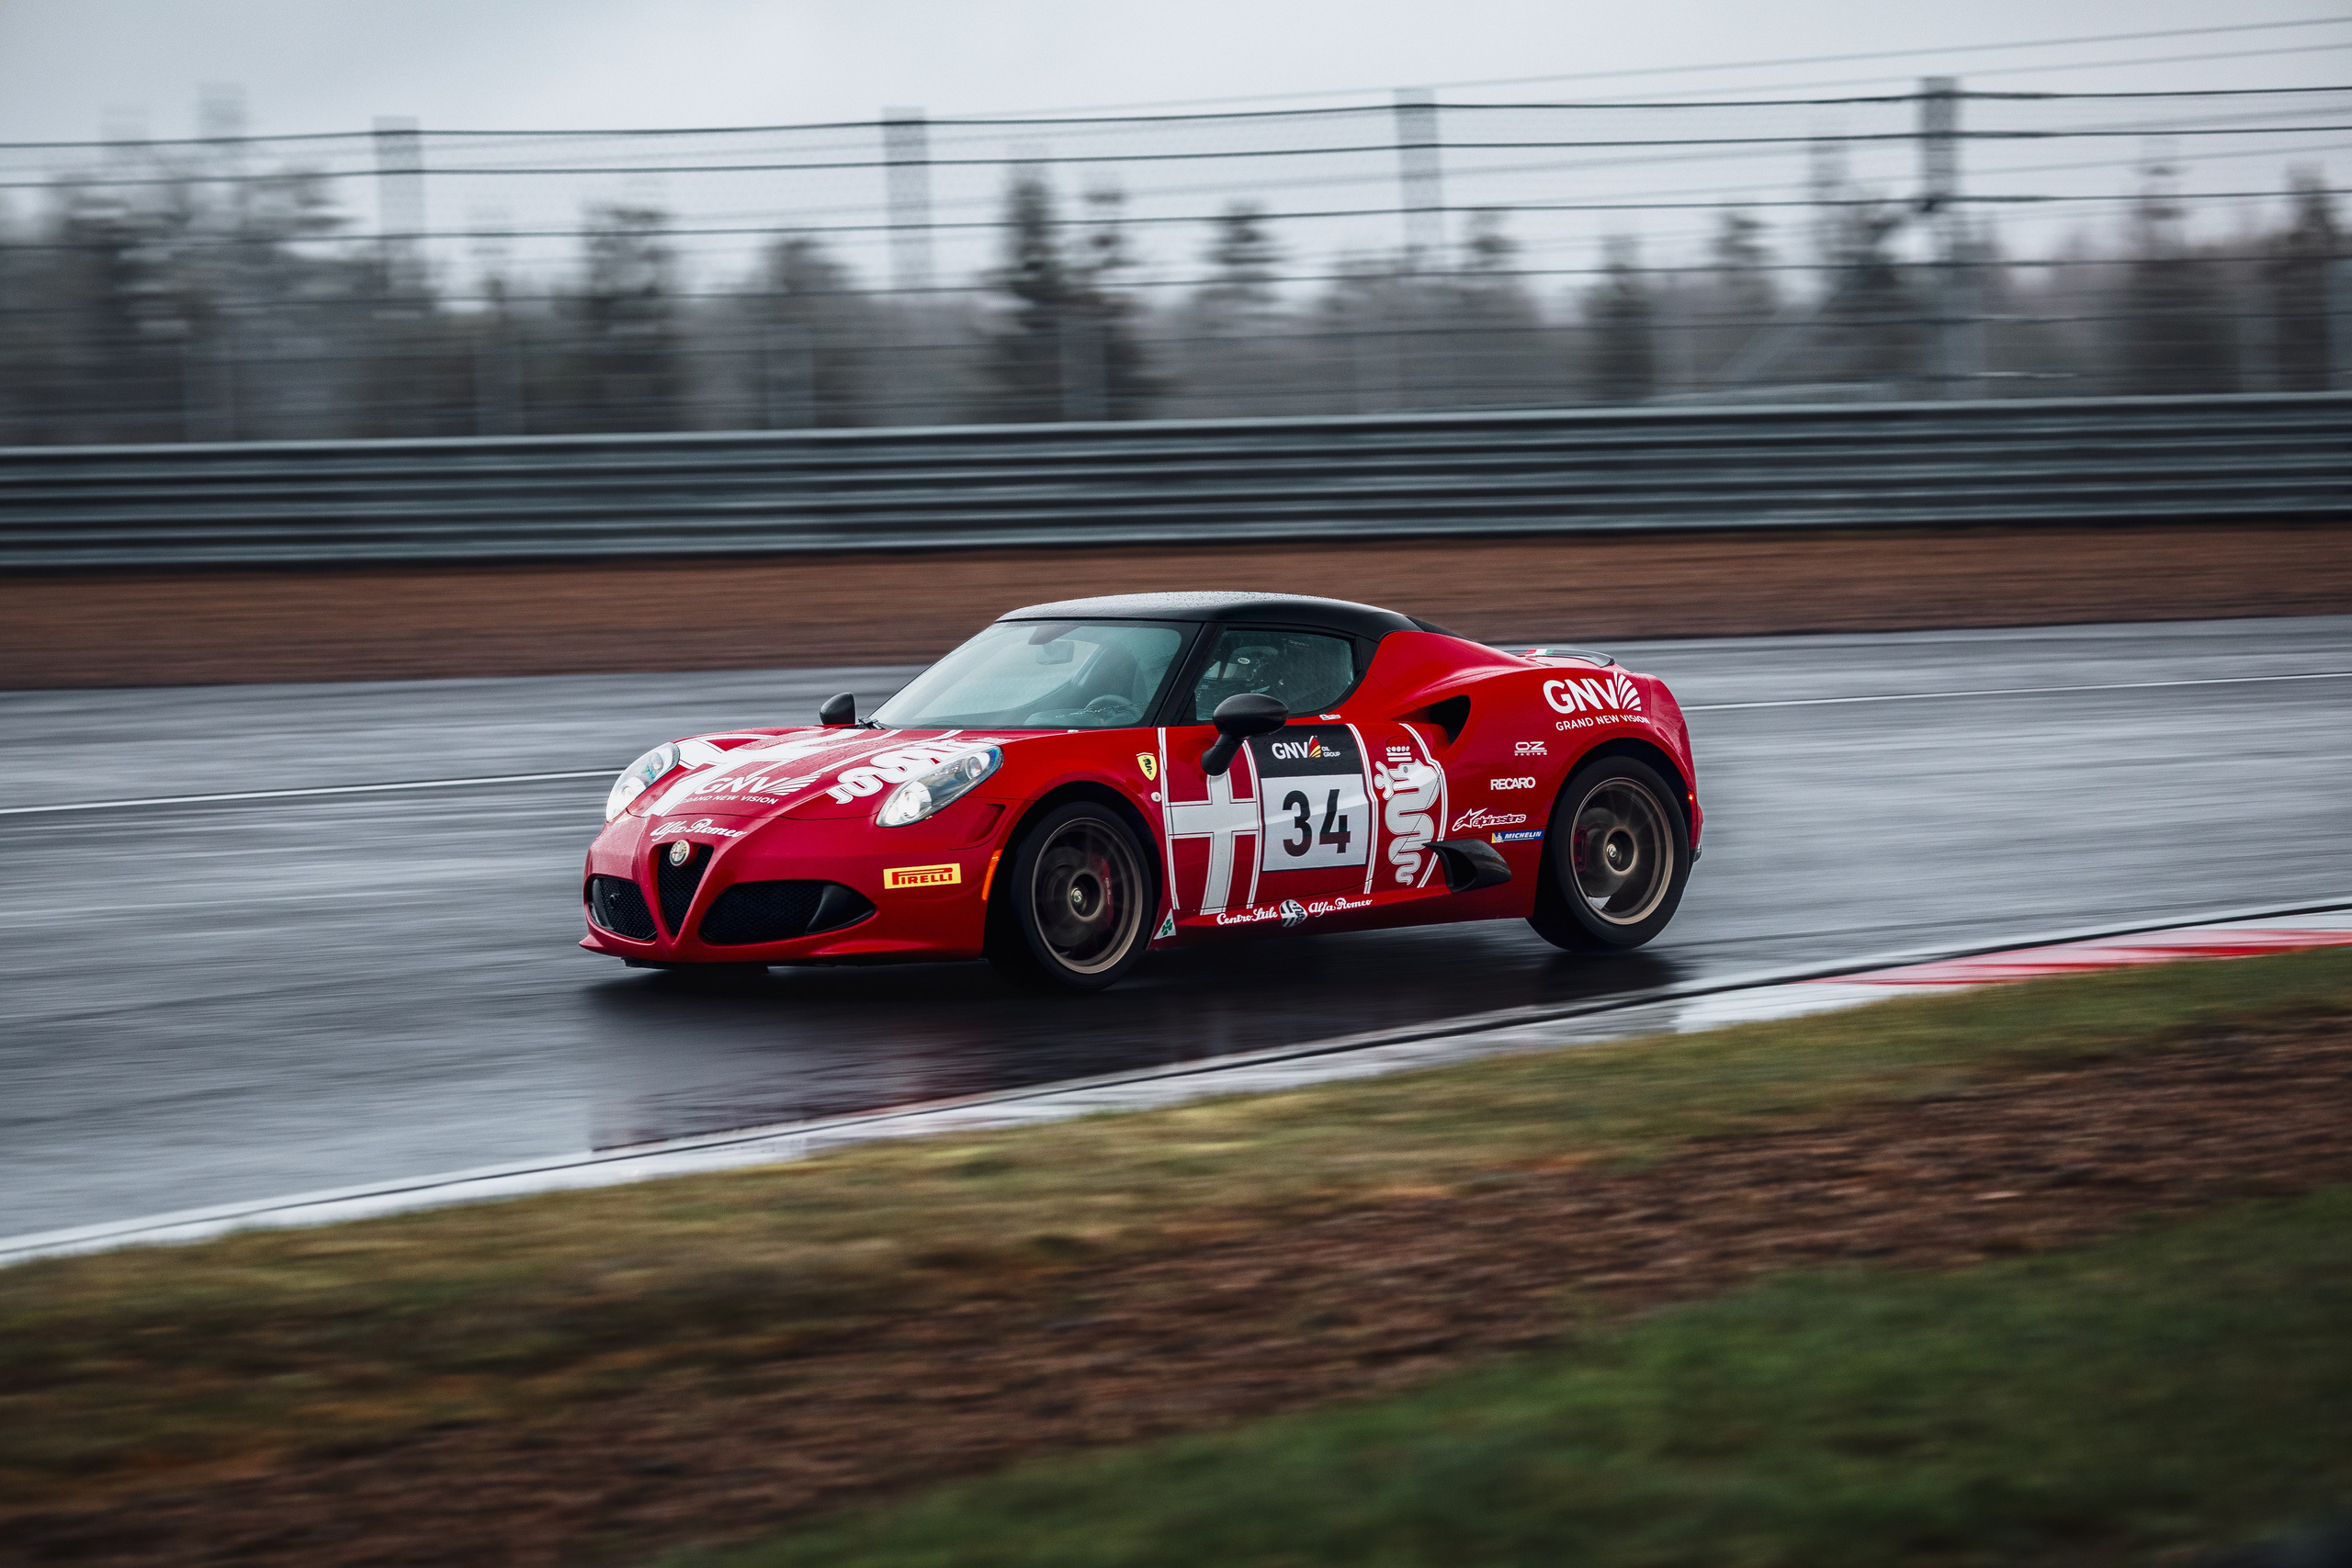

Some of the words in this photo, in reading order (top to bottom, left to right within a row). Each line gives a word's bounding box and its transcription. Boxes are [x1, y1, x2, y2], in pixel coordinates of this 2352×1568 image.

[1544, 678, 1620, 714] GNV
[1555, 717, 1594, 731] GRAND
[1595, 715, 1620, 725] NEW
[1620, 714, 1651, 725] VISION
[1272, 741, 1308, 760] GNV
[695, 777, 770, 795] GNV
[1490, 776, 1536, 791] RECARO
[741, 795, 779, 805] VISION
[650, 820, 689, 842] Alfa
[688, 818, 748, 838] Romeo
[1282, 788, 1351, 857] 34
[1504, 830, 1543, 840] MICHELIN
[891, 867, 953, 886] PIRELLI
[1307, 902, 1335, 918] Alfa
[1333, 897, 1373, 910] Romeo
[1216, 912, 1253, 926] Centro
